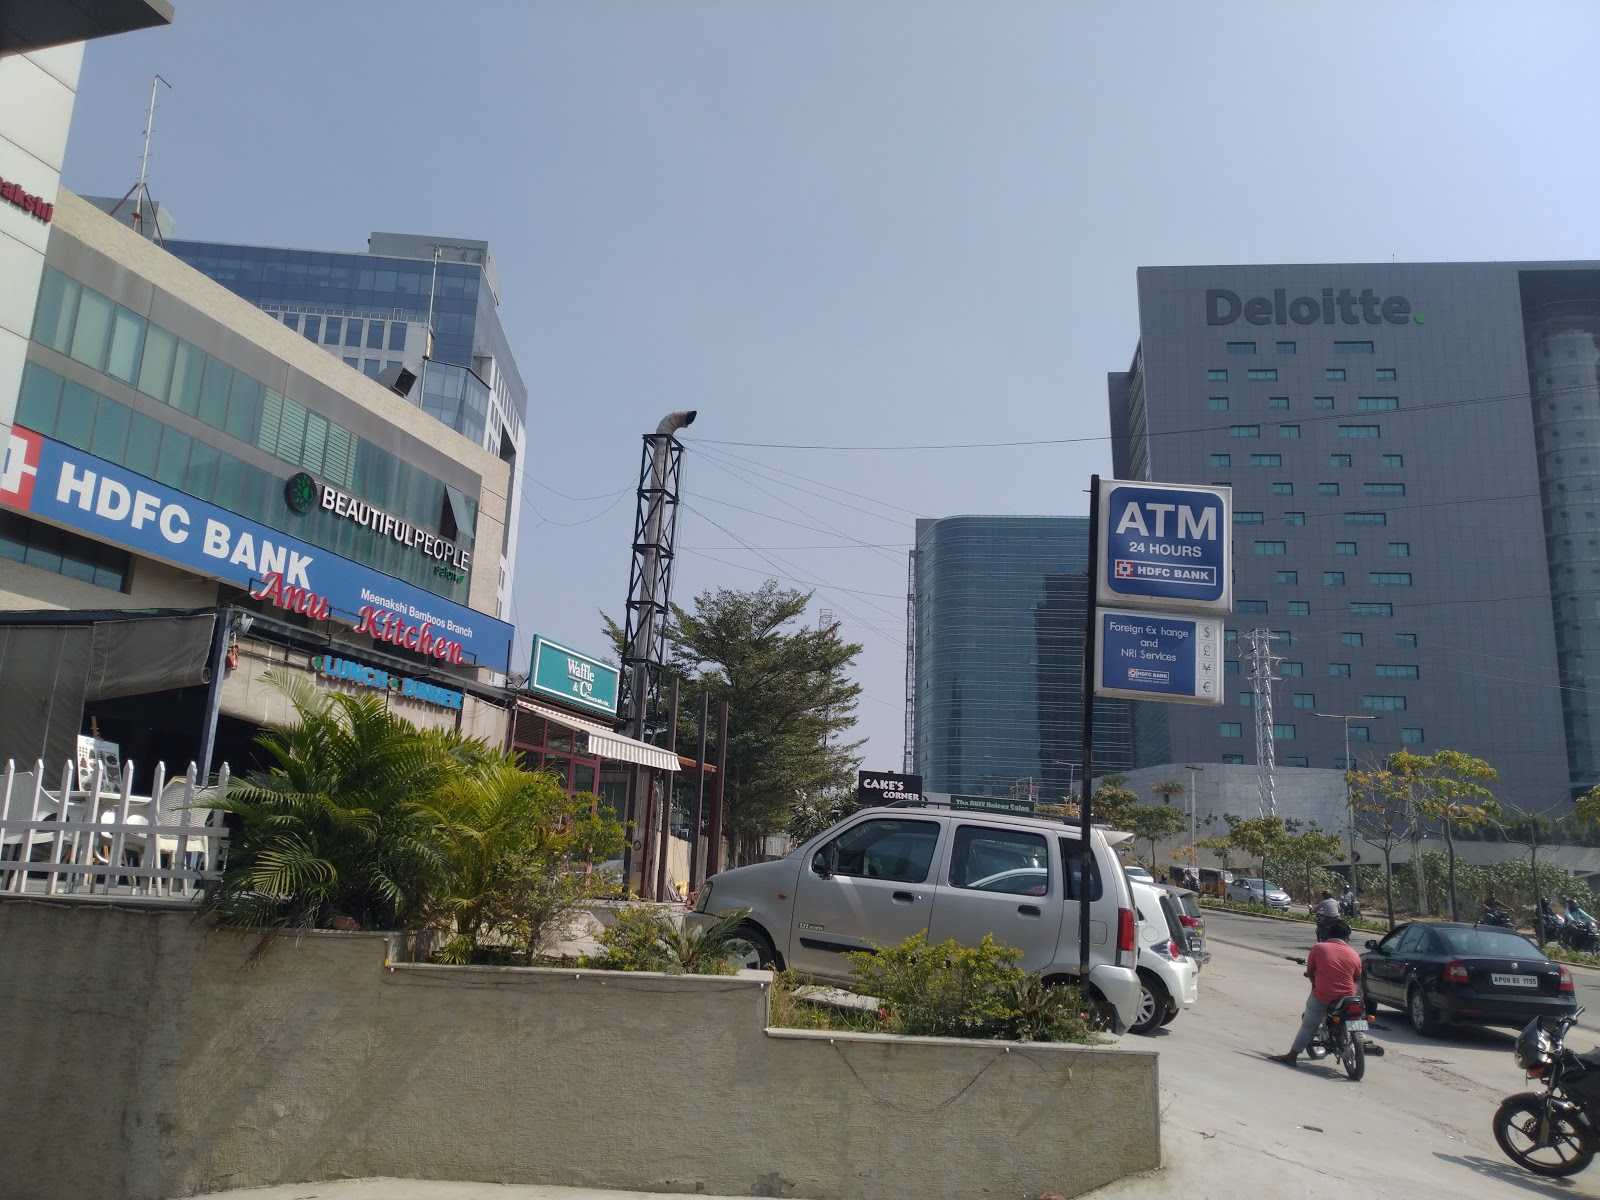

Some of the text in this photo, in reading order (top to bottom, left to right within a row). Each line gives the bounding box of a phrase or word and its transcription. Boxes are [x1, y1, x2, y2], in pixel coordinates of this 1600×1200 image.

[57, 461, 314, 590] HDFC BANK
[1115, 501, 1217, 541] ATM
[1129, 541, 1202, 558] 24 HOURS
[1137, 566, 1210, 581] HDFC BANK
[249, 571, 464, 664] Anu Kitchen
[360, 587, 473, 639] Meenakshi Bamboos Branch
[1109, 621, 1144, 635] Foreign
[1140, 639, 1159, 648] and
[1121, 648, 1177, 662] NRI Services
[566, 658, 595, 682] Waffle
[323, 655, 464, 710] LUNCH DINNER
[863, 778, 904, 791] CAKE'S
[882, 791, 920, 801] CORNER
